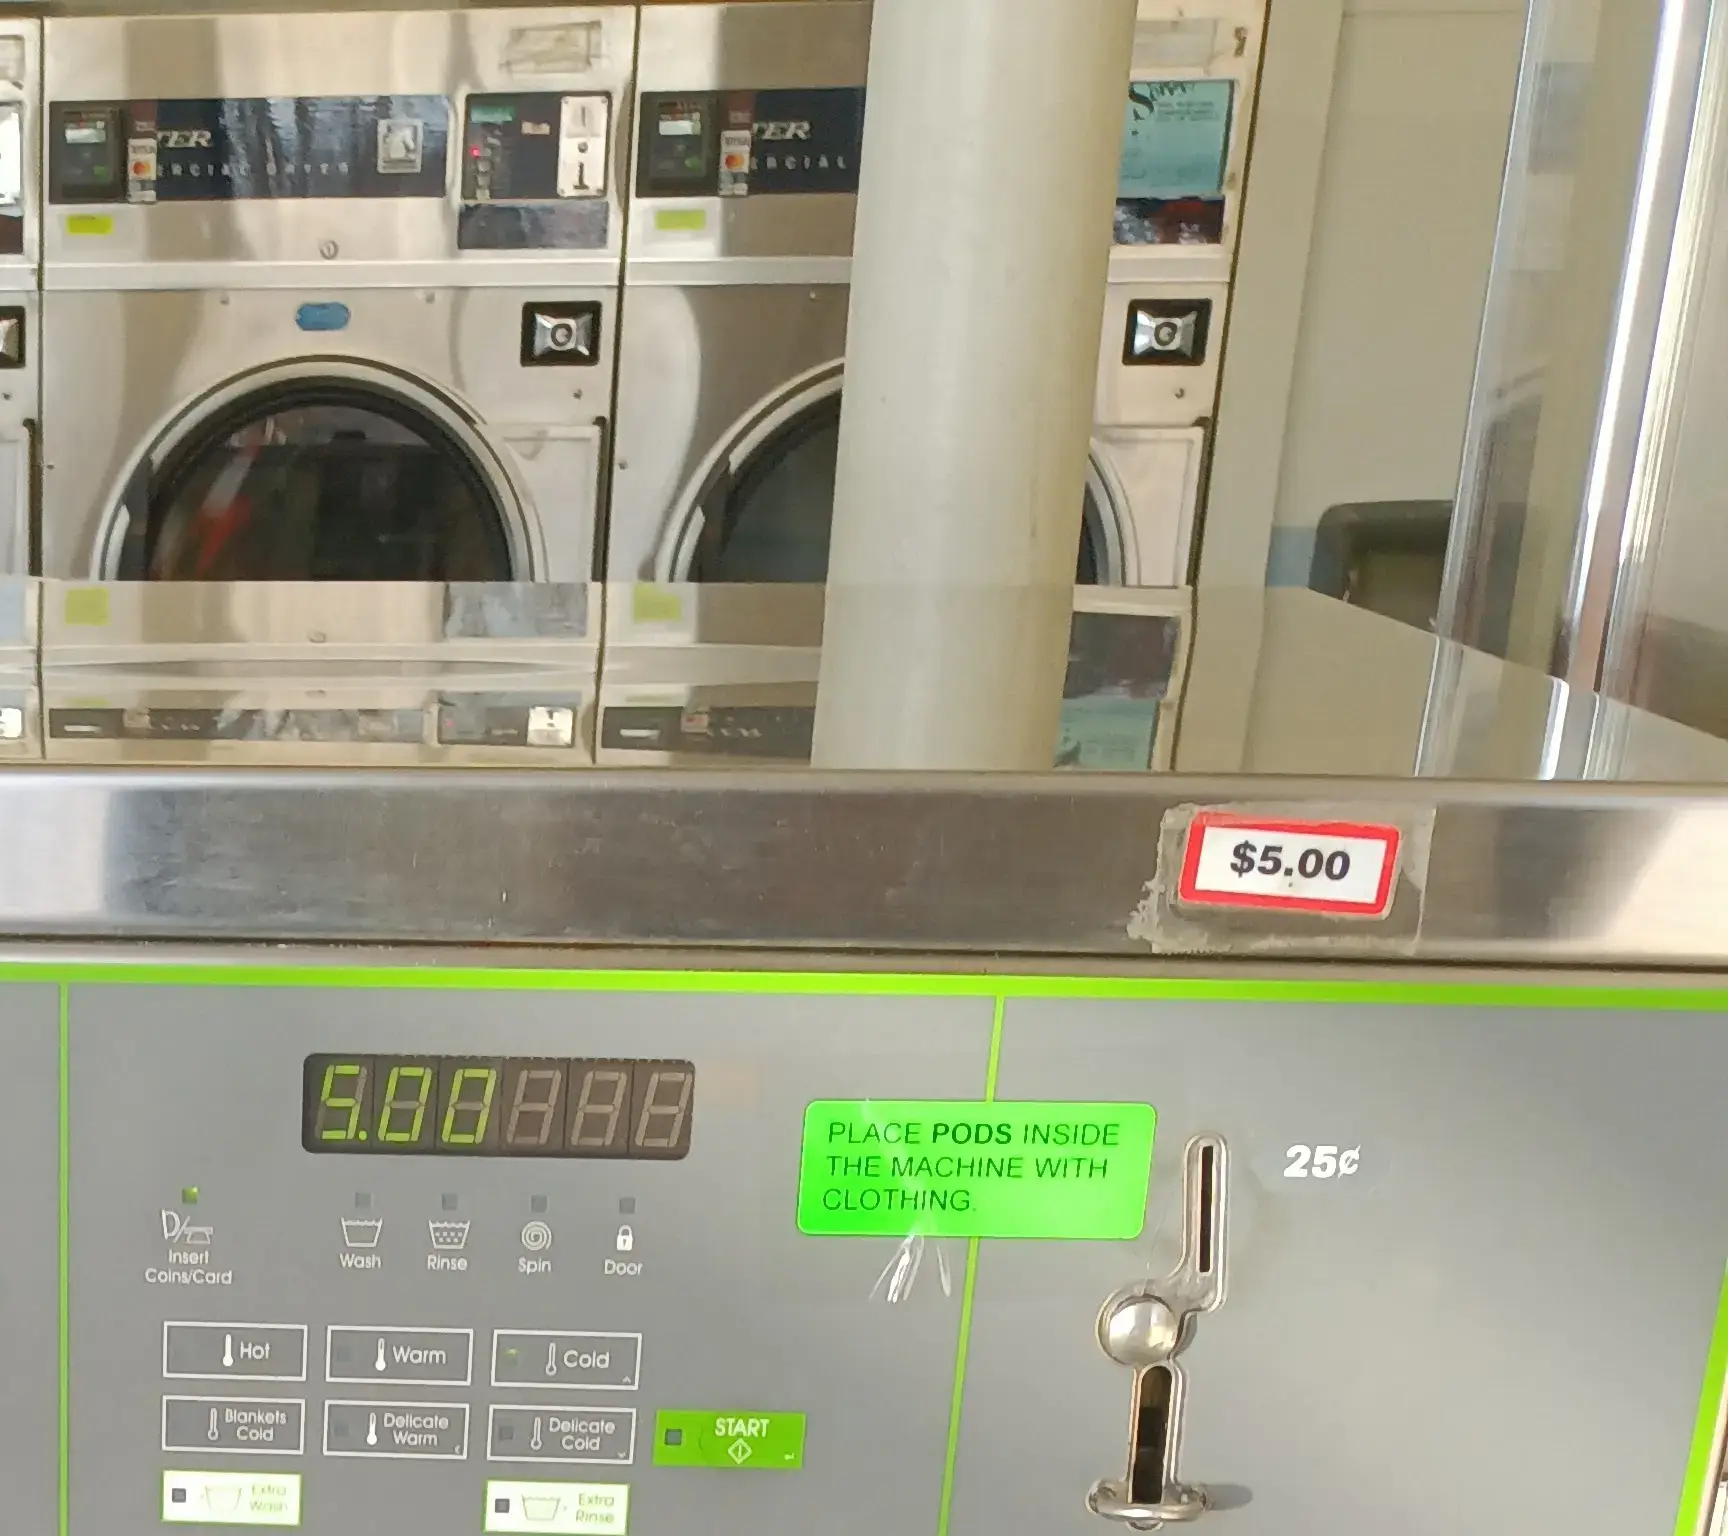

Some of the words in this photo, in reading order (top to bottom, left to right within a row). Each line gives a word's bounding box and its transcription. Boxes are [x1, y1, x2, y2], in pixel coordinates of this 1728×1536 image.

[1230, 840, 1351, 881] $5.00
[319, 1063, 498, 1145] 5.00
[828, 1121, 922, 1146] PLACE
[931, 1121, 1013, 1146] PODS
[1023, 1123, 1122, 1148] INSIDE
[825, 1155, 883, 1179] THE
[890, 1155, 1025, 1180] MACHINE
[1034, 1157, 1109, 1180] WITH
[1283, 1144, 1361, 1180] 25¢
[823, 1188, 977, 1213] CLOTHING.
[168, 1248, 210, 1266] Insert
[339, 1252, 382, 1270] Wash
[427, 1254, 469, 1272] Rinse
[518, 1255, 552, 1276] Spin
[145, 1267, 233, 1286] Coins/Card
[604, 1258, 644, 1277] Door
[240, 1341, 271, 1360] Hot
[392, 1345, 447, 1365] Warm
[563, 1349, 611, 1370] Cold
[225, 1407, 288, 1426] Blankets
[383, 1412, 450, 1431] Delicate
[547, 1416, 617, 1436] Delicate
[235, 1425, 275, 1443] Cold
[714, 1416, 771, 1439] START
[392, 1430, 439, 1447] Warm
[561, 1434, 601, 1452] Cold
[251, 1483, 288, 1497] Extra
[248, 1499, 289, 1513] Wash
[577, 1492, 615, 1508] Extra
[574, 1508, 615, 1524] Rinse
